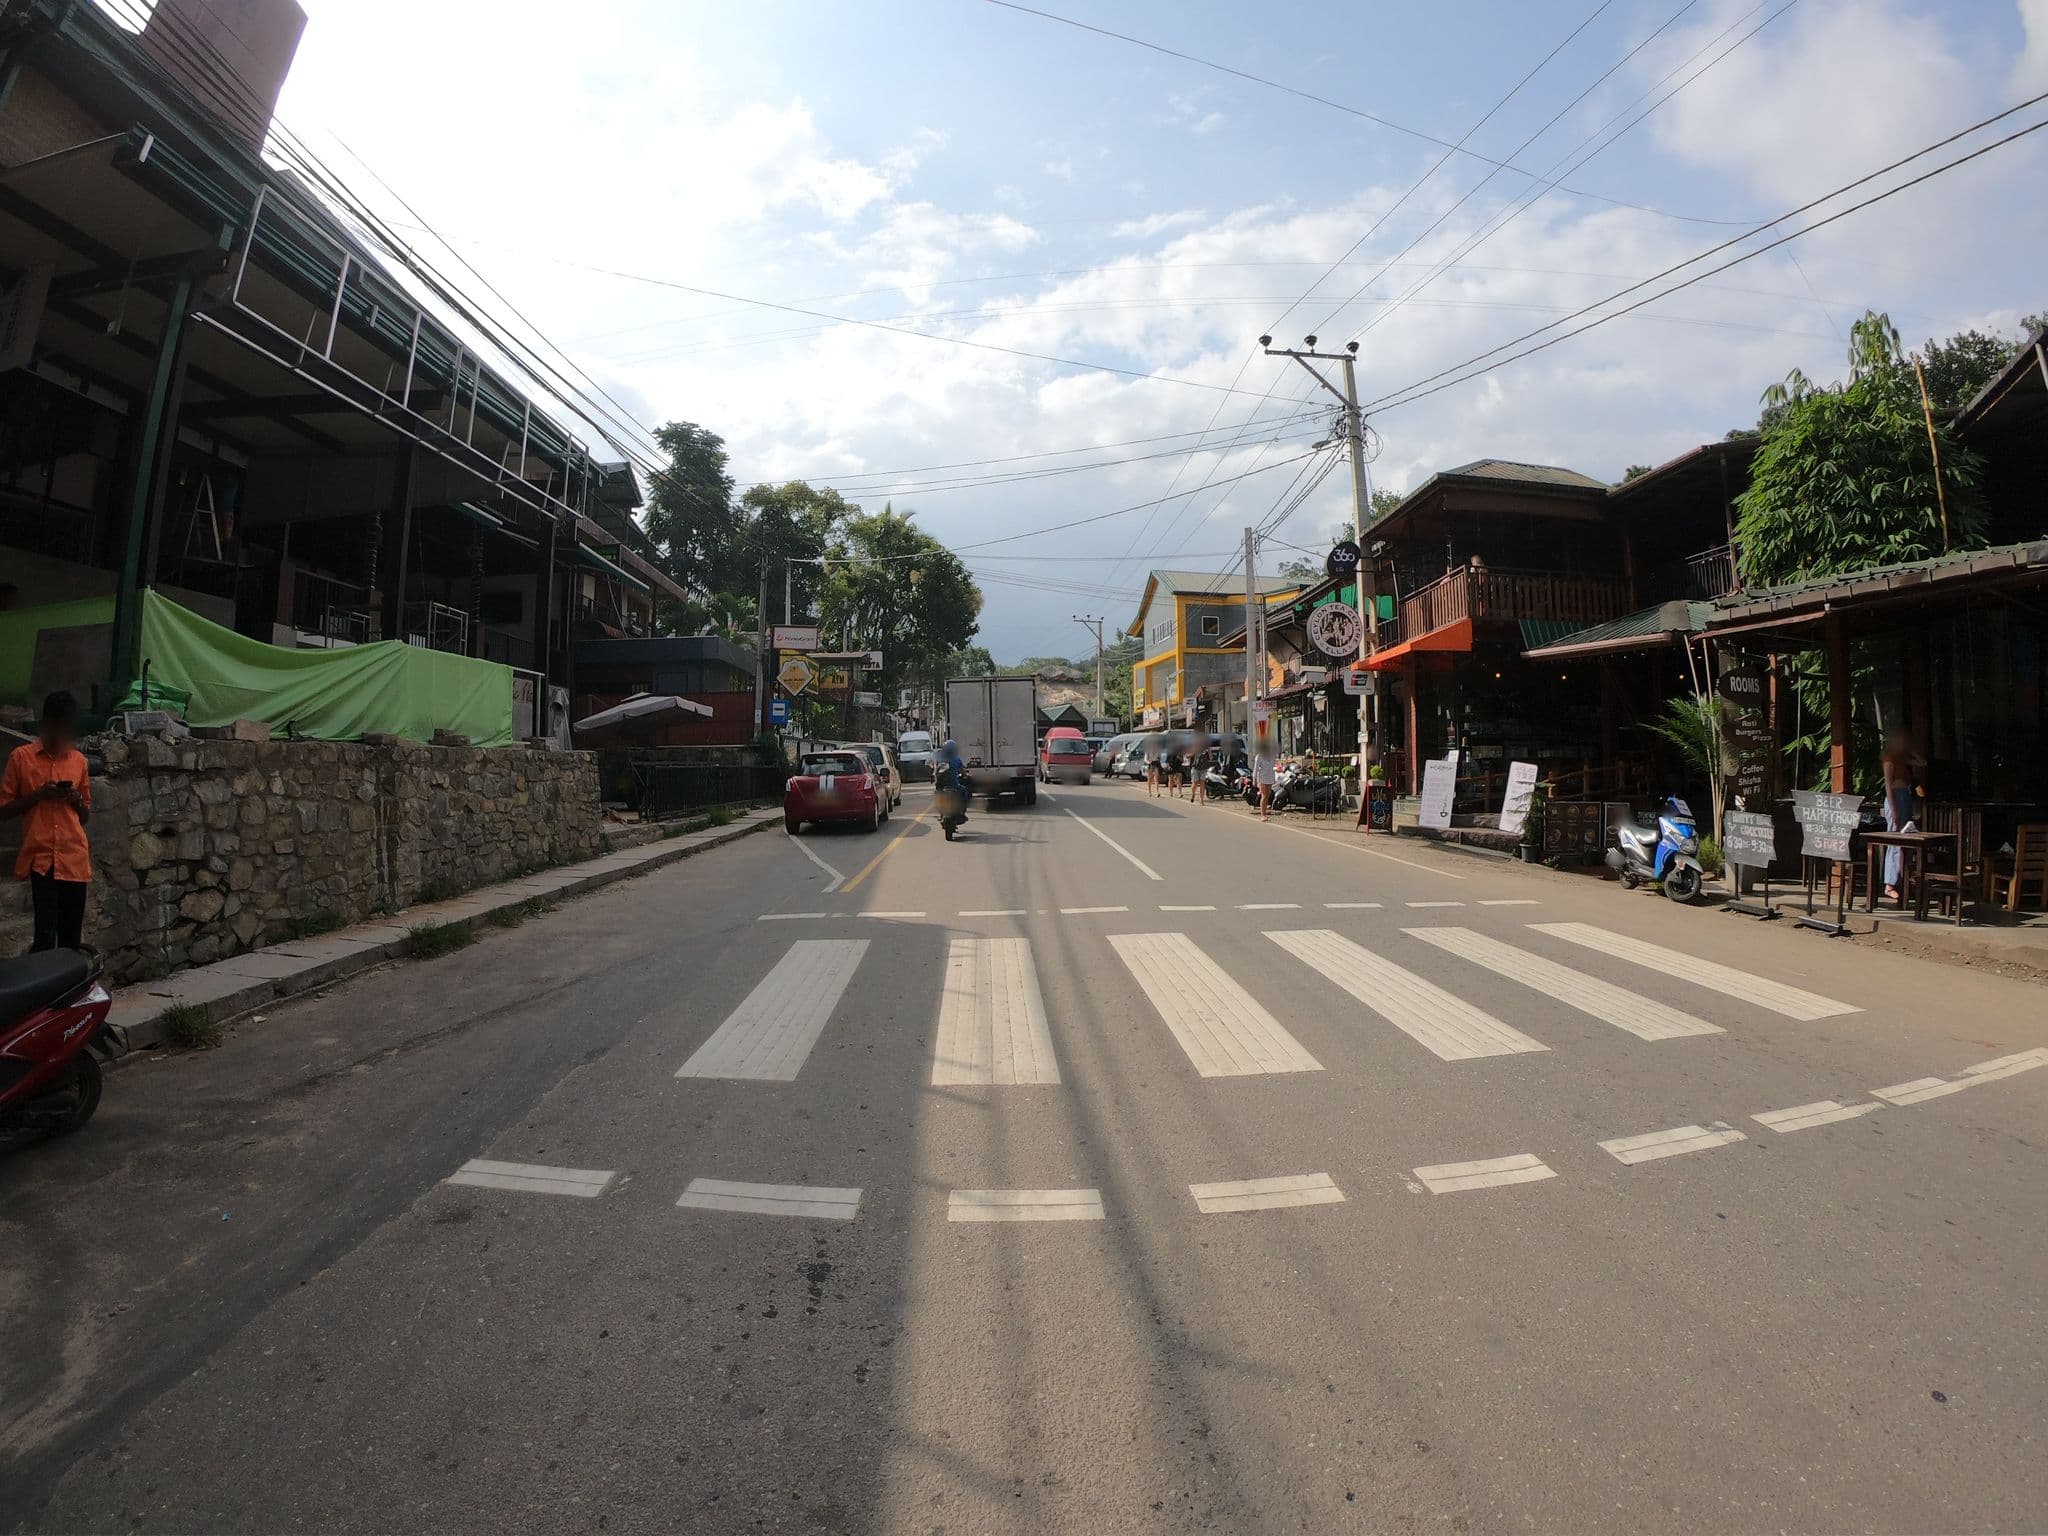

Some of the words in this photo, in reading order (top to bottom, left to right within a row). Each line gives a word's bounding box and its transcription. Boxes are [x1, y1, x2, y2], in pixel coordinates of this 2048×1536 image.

[1333, 548, 1355, 562] 360
[1313, 608, 1328, 641] CEYLON
[1347, 610, 1361, 643] CENTRE
[1325, 646, 1349, 656] ELLA
[831, 674, 845, 685] ATM
[1730, 676, 1760, 694] ROOMS
[1735, 729, 1762, 738] Burgers
[1742, 764, 1765, 775] Coffee
[1816, 794, 1843, 810] BEER
